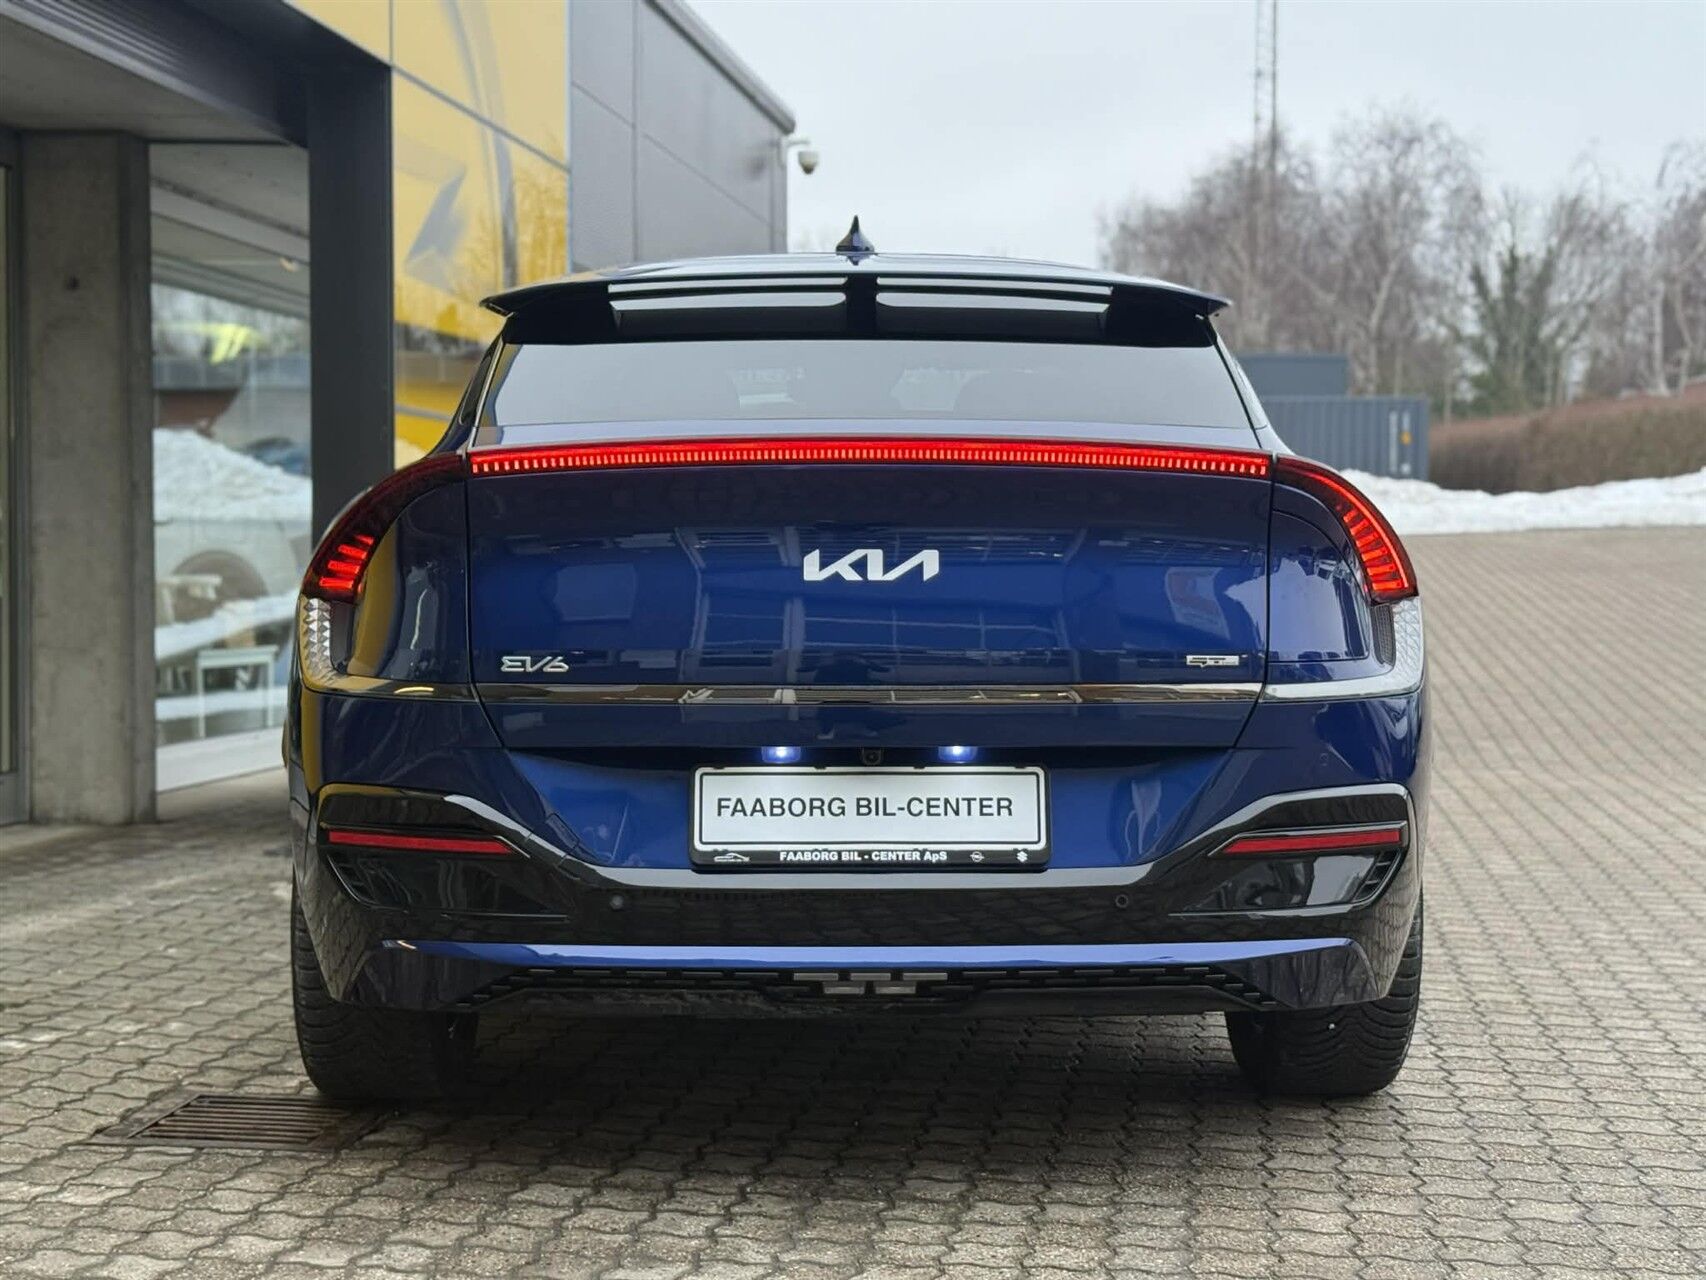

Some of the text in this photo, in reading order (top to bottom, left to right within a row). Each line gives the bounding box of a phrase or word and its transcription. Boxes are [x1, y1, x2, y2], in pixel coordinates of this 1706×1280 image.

[500, 655, 570, 673] EV6
[716, 796, 1014, 818] FAABORG BIL-CENTER
[779, 851, 839, 862] FAABORG
[841, 851, 862, 861] BIL
[871, 851, 921, 862] CENTER
[923, 851, 948, 863] ApS
